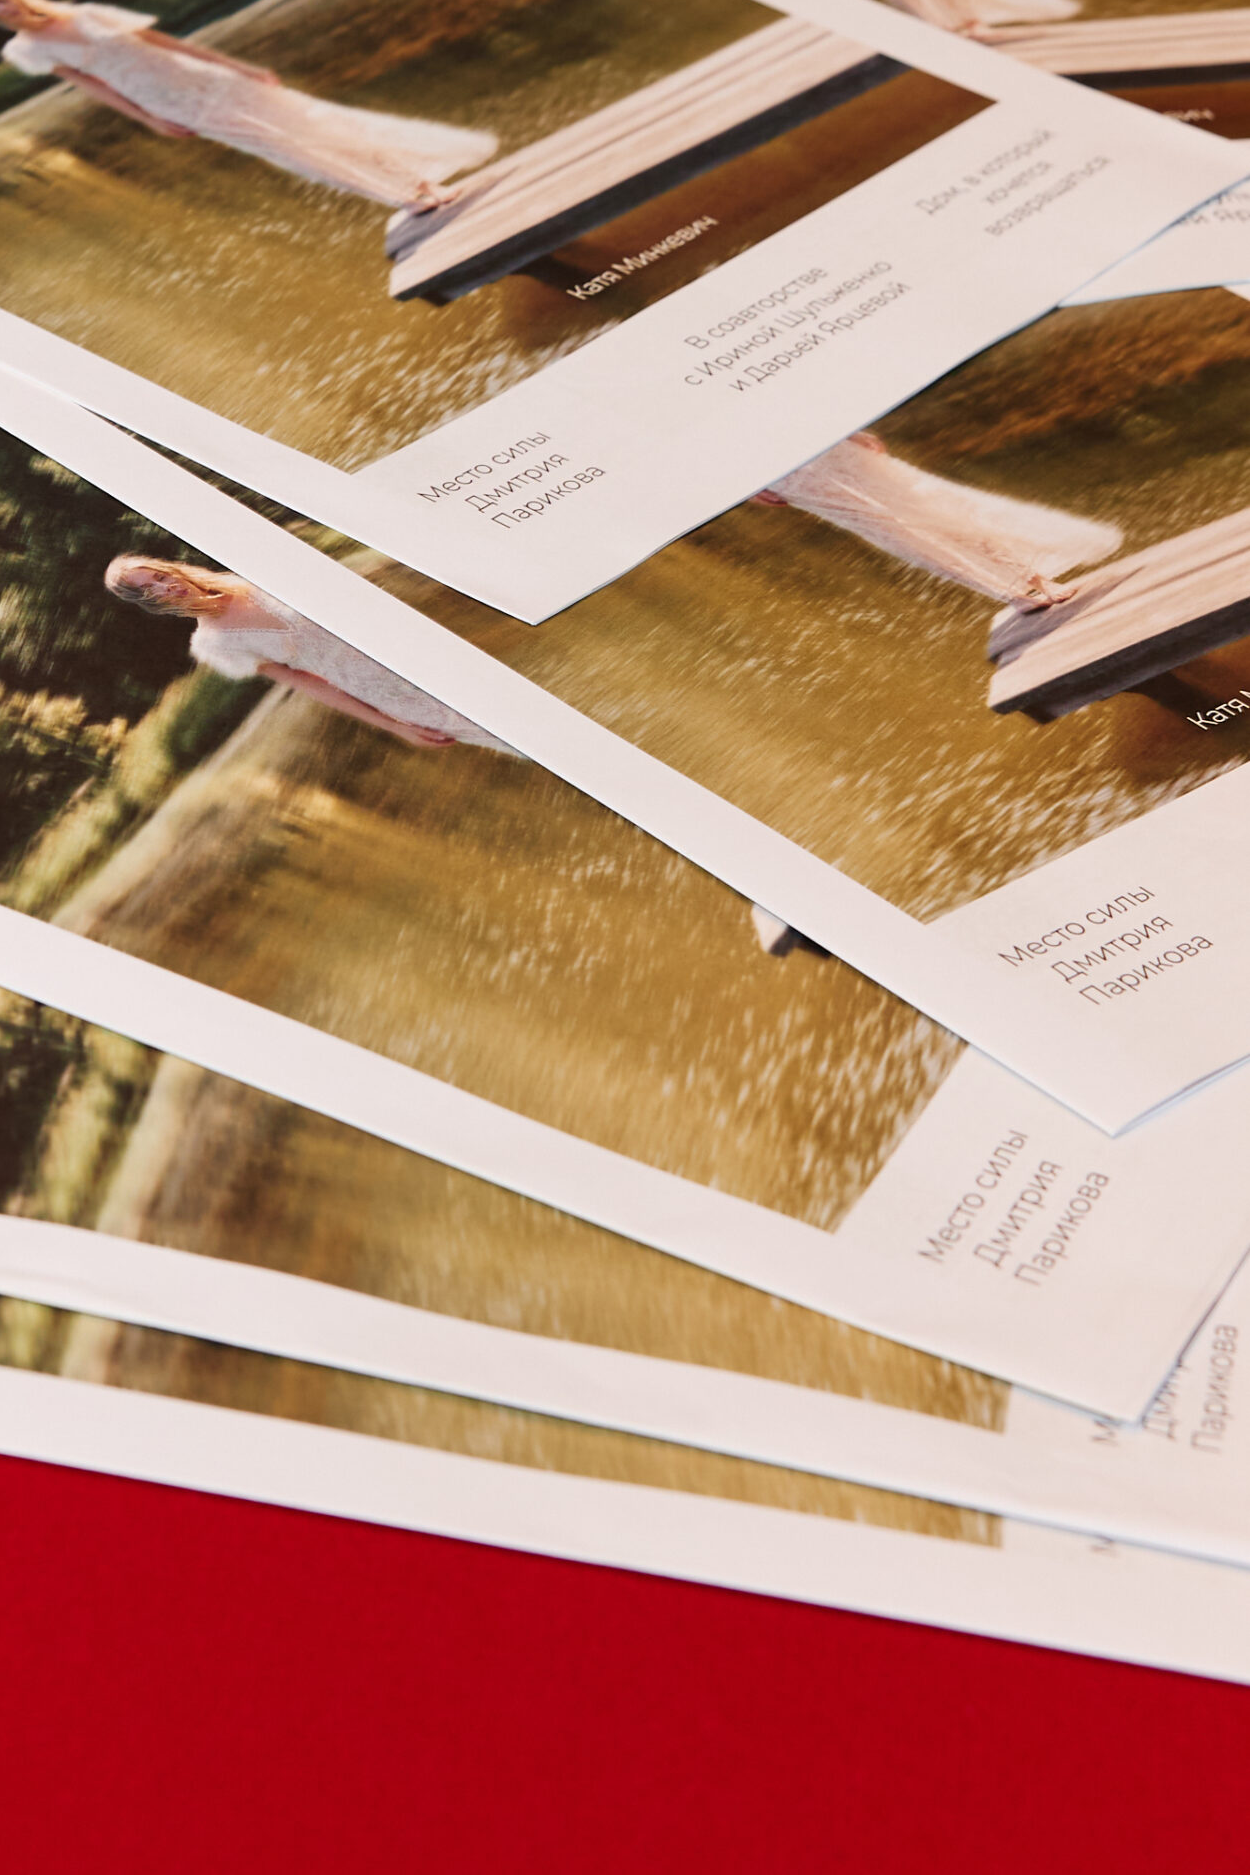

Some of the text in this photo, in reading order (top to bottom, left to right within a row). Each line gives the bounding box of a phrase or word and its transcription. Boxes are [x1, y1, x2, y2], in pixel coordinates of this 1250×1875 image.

[565, 213, 720, 301] Катя Минкевич
[683, 265, 829, 351] В соавторстве
[683, 259, 894, 387] с Ириной Шульженко
[728, 278, 913, 393] и Дарьей Ярцевой
[416, 431, 553, 503] Место силы
[464, 452, 570, 514] Дмитрия
[490, 465, 607, 530] Парикова
[1186, 698, 1250, 730] Катя
[997, 885, 1157, 968] Место силы
[1050, 915, 1174, 985] Дмитрия
[1078, 934, 1215, 1006] Парикова
[917, 1128, 1030, 1264] Место силы
[972, 1159, 1064, 1269] Дмитрия
[1013, 1171, 1111, 1287] Парикова
[1189, 1324, 1240, 1455] Парикова
